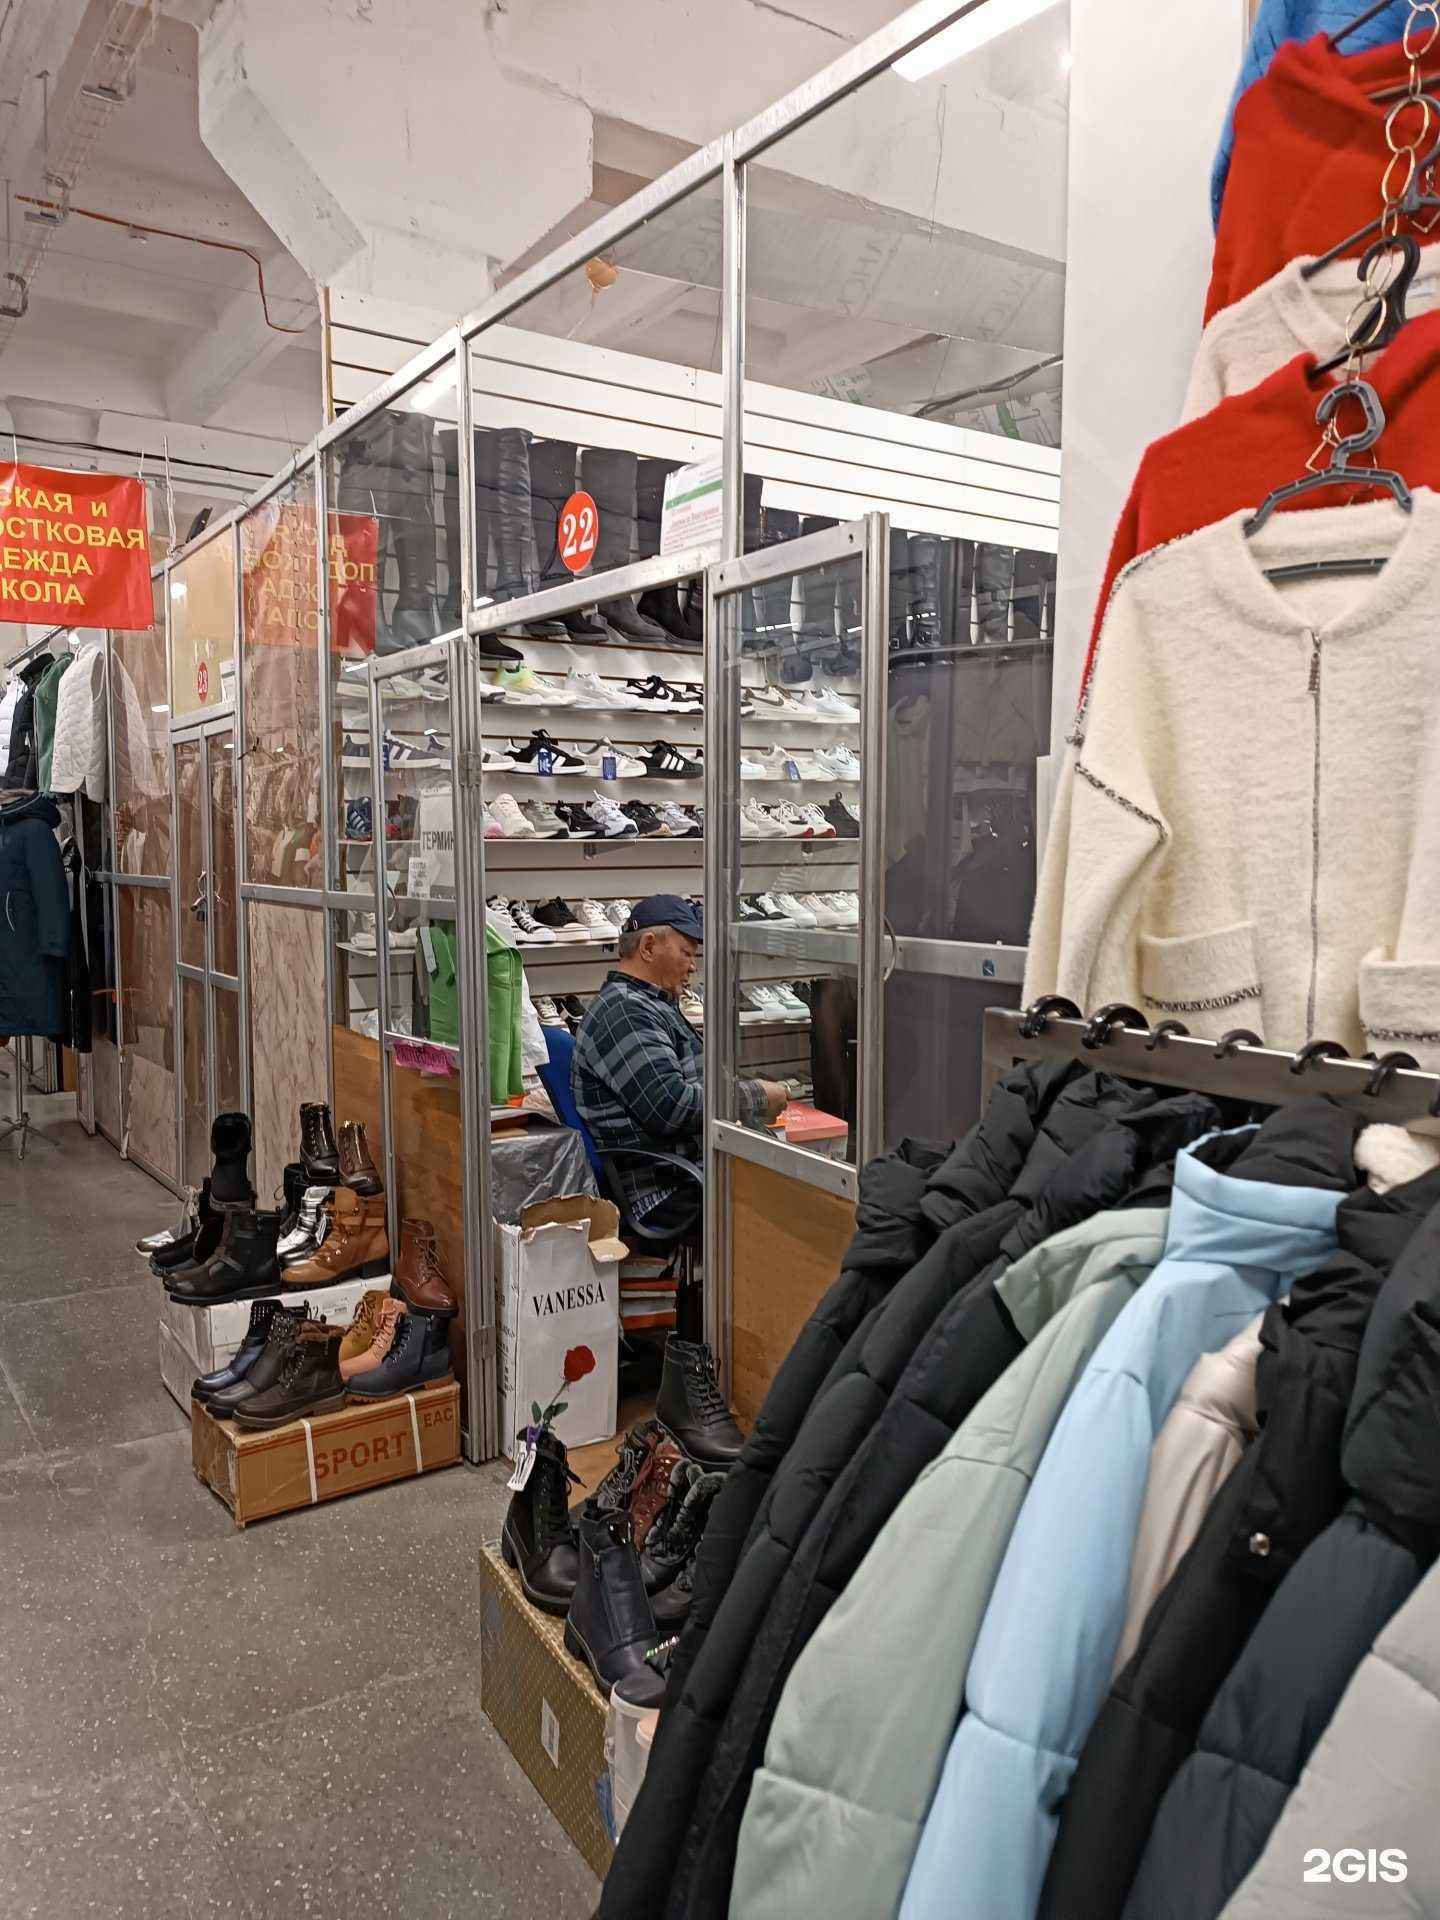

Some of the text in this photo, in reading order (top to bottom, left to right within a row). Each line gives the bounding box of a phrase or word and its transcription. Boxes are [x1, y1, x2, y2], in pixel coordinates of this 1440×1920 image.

[0, 516, 146, 550] СТКОВАЯ
[562, 507, 594, 558] 22
[0, 546, 94, 578] ЕЖДА
[533, 1281, 606, 1317] VANESSA
[314, 1431, 408, 1480] SPORT
